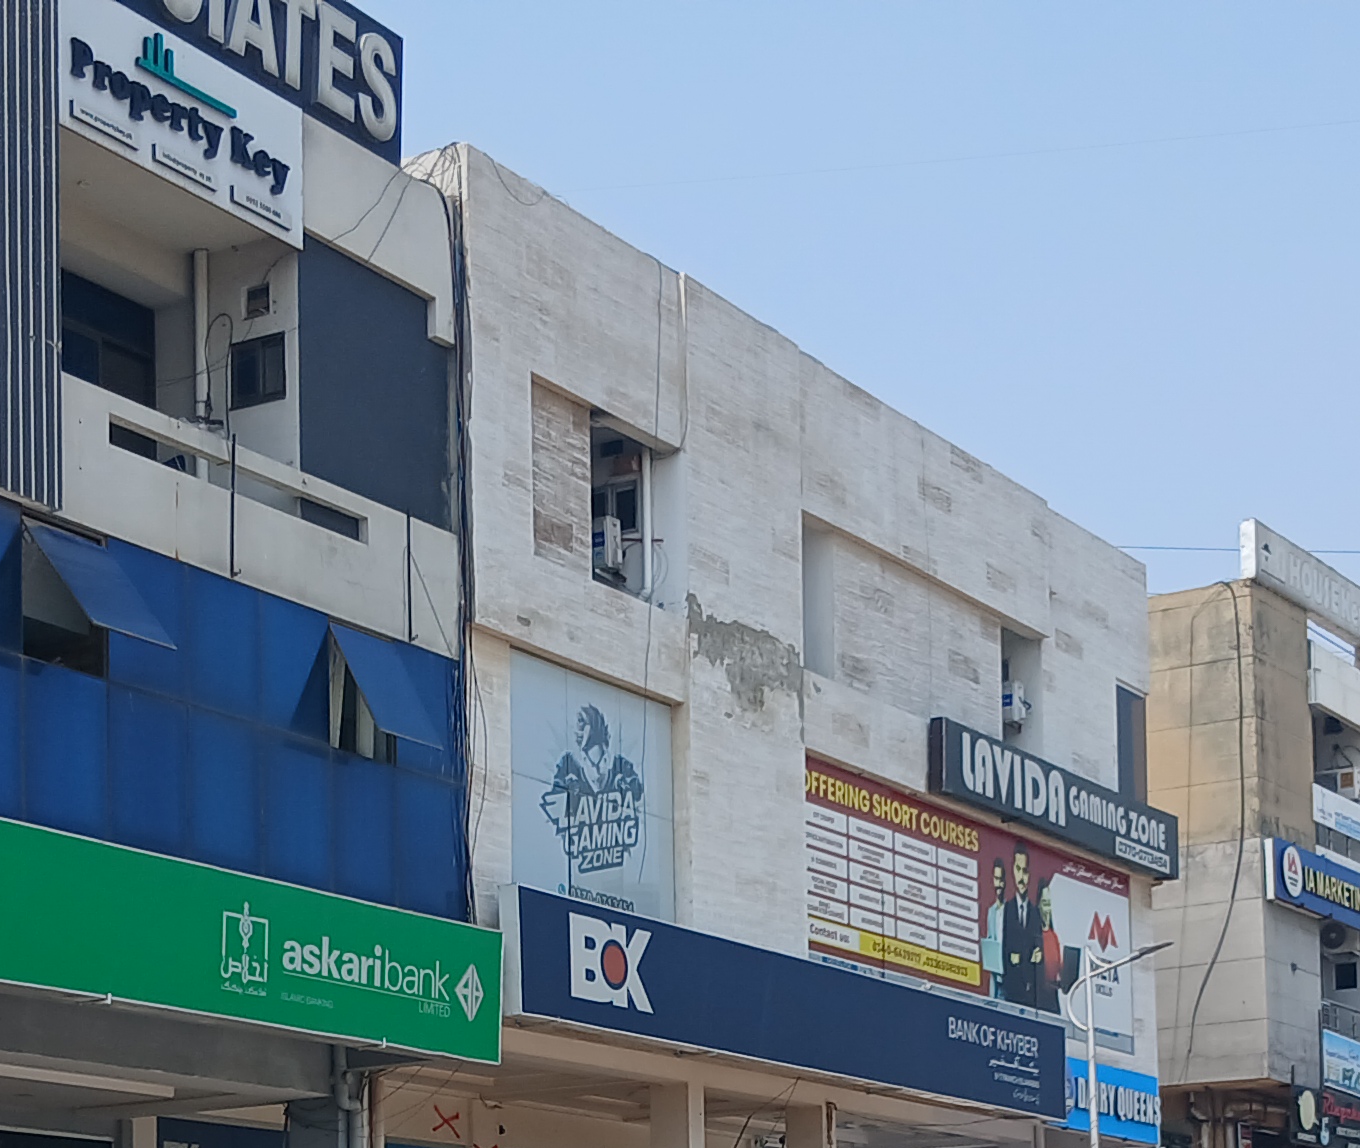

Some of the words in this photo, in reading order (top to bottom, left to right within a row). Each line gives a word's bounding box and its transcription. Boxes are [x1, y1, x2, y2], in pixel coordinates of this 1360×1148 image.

[70, 37, 224, 159] Property
[229, 125, 292, 196] Key
[543, 790, 637, 827] LAVIDA
[805, 769, 870, 813] OFFERING
[872, 794, 918, 831] SHORT
[920, 812, 979, 851] COURSES
[962, 732, 1066, 827] LAVIDA
[1069, 786, 1127, 835] GAMING
[1129, 810, 1166, 850] ZONE
[564, 820, 637, 858] GAMING
[580, 848, 624, 870] ZONE
[282, 936, 450, 1001] askaribank
[418, 1001, 451, 1018] LIMITED
[947, 1016, 979, 1045] BANK
[980, 1025, 995, 1048] OF
[997, 1029, 1038, 1058] KHYBER
[1117, 1086, 1162, 1126] QUEENS
